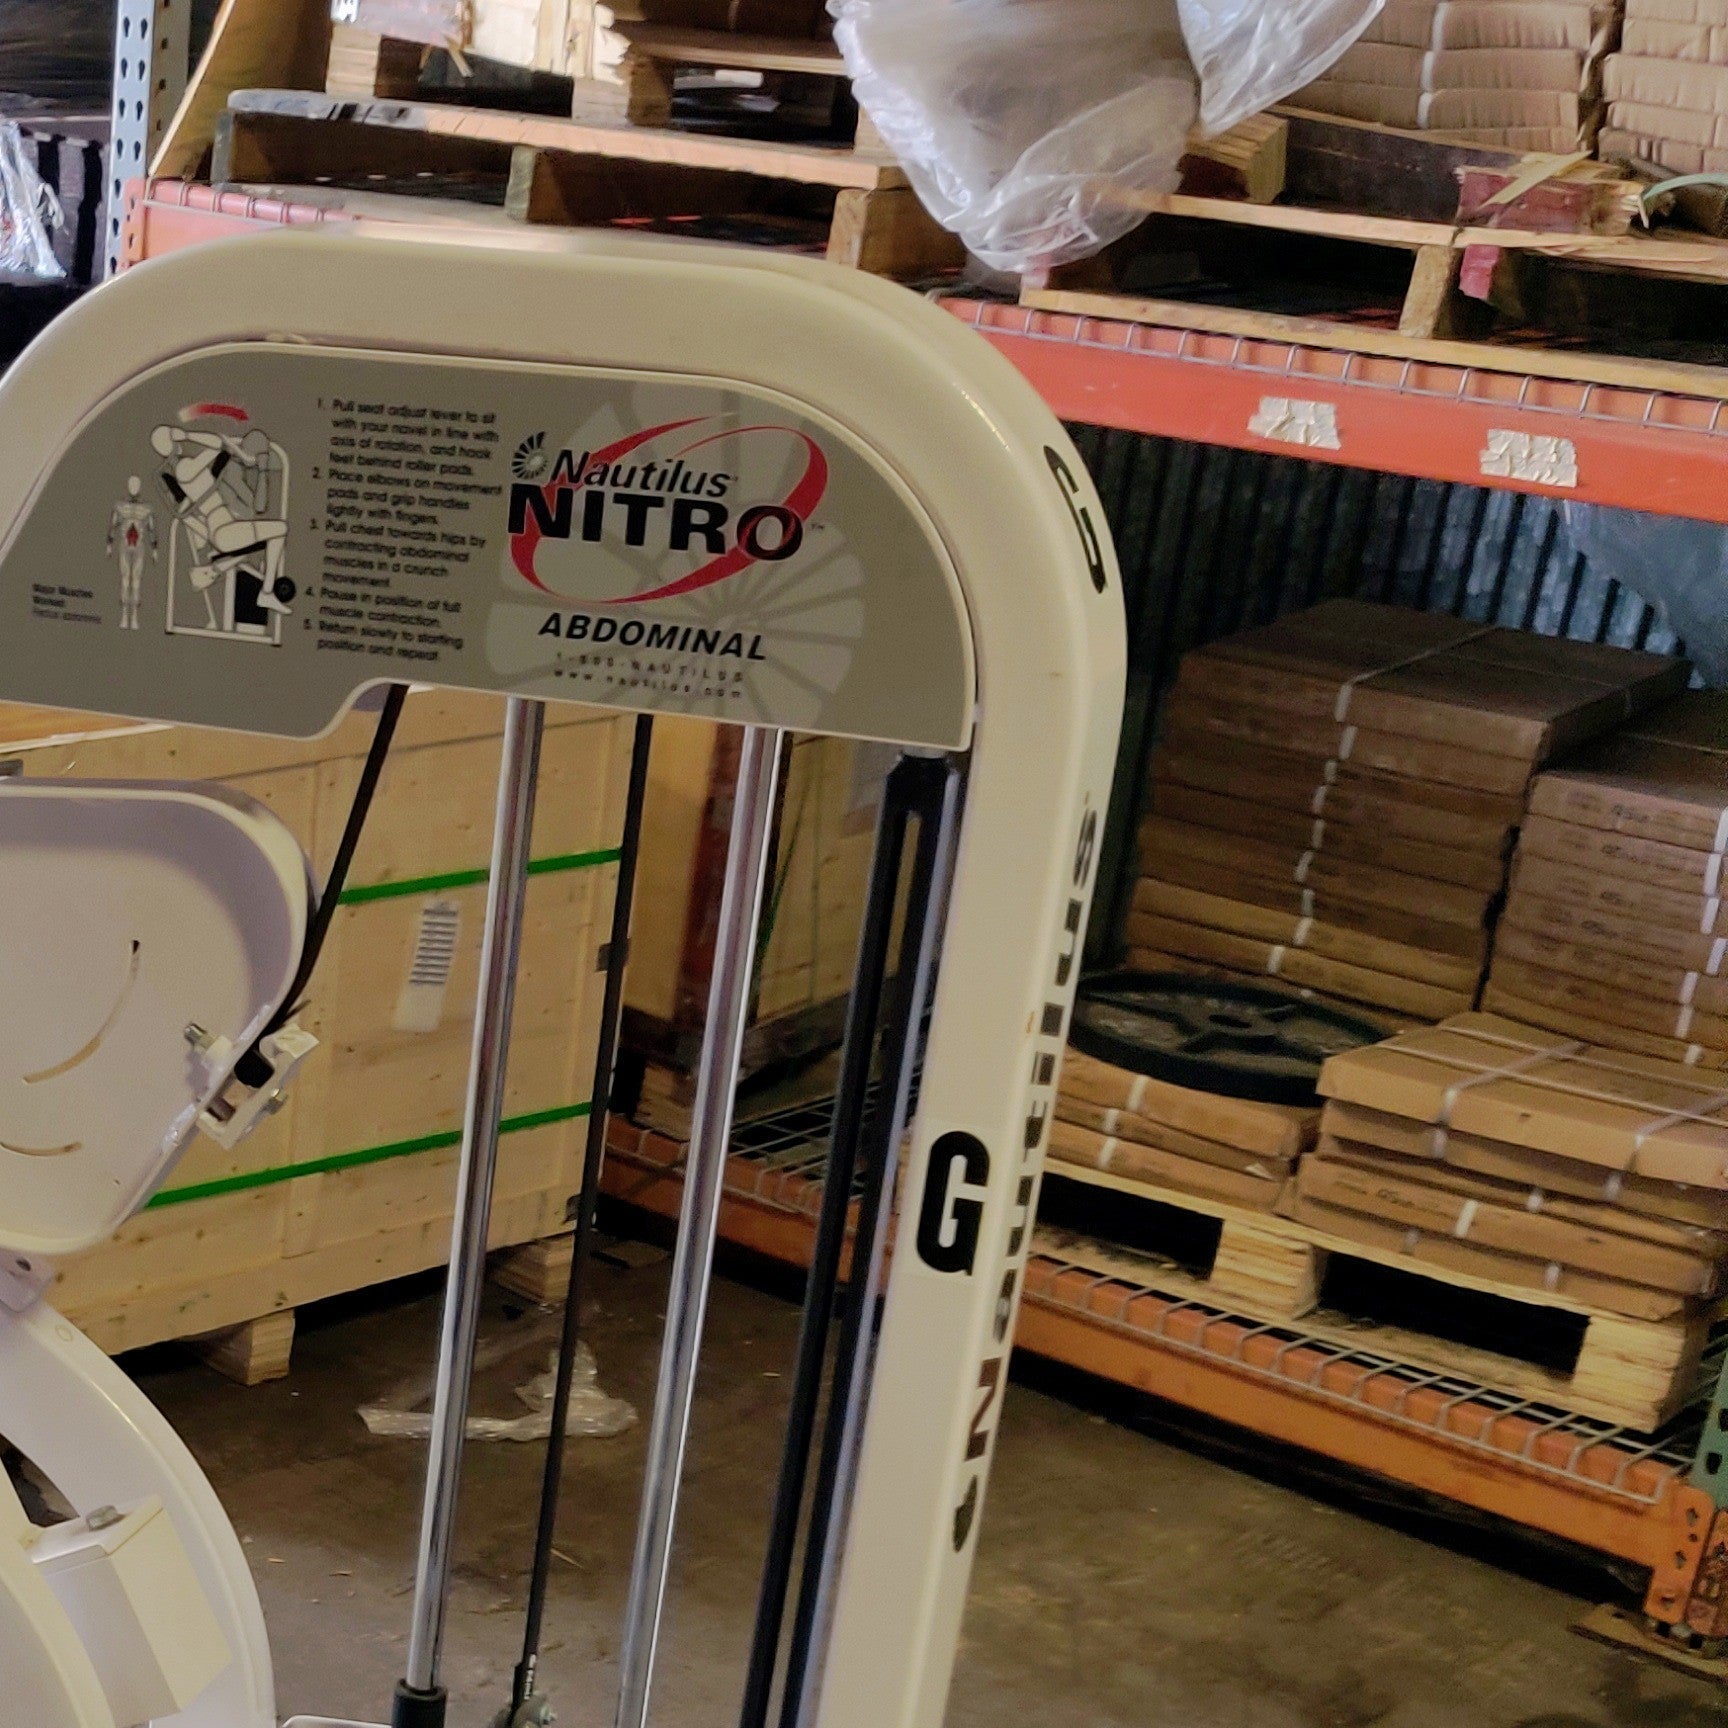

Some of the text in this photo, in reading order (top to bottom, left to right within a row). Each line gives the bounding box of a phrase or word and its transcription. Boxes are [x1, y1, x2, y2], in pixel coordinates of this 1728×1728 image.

[551, 448, 732, 497] Nautilus
[508, 482, 804, 561] NITRO
[538, 612, 767, 661] ABDOMINAL
[916, 1130, 991, 1277] G
